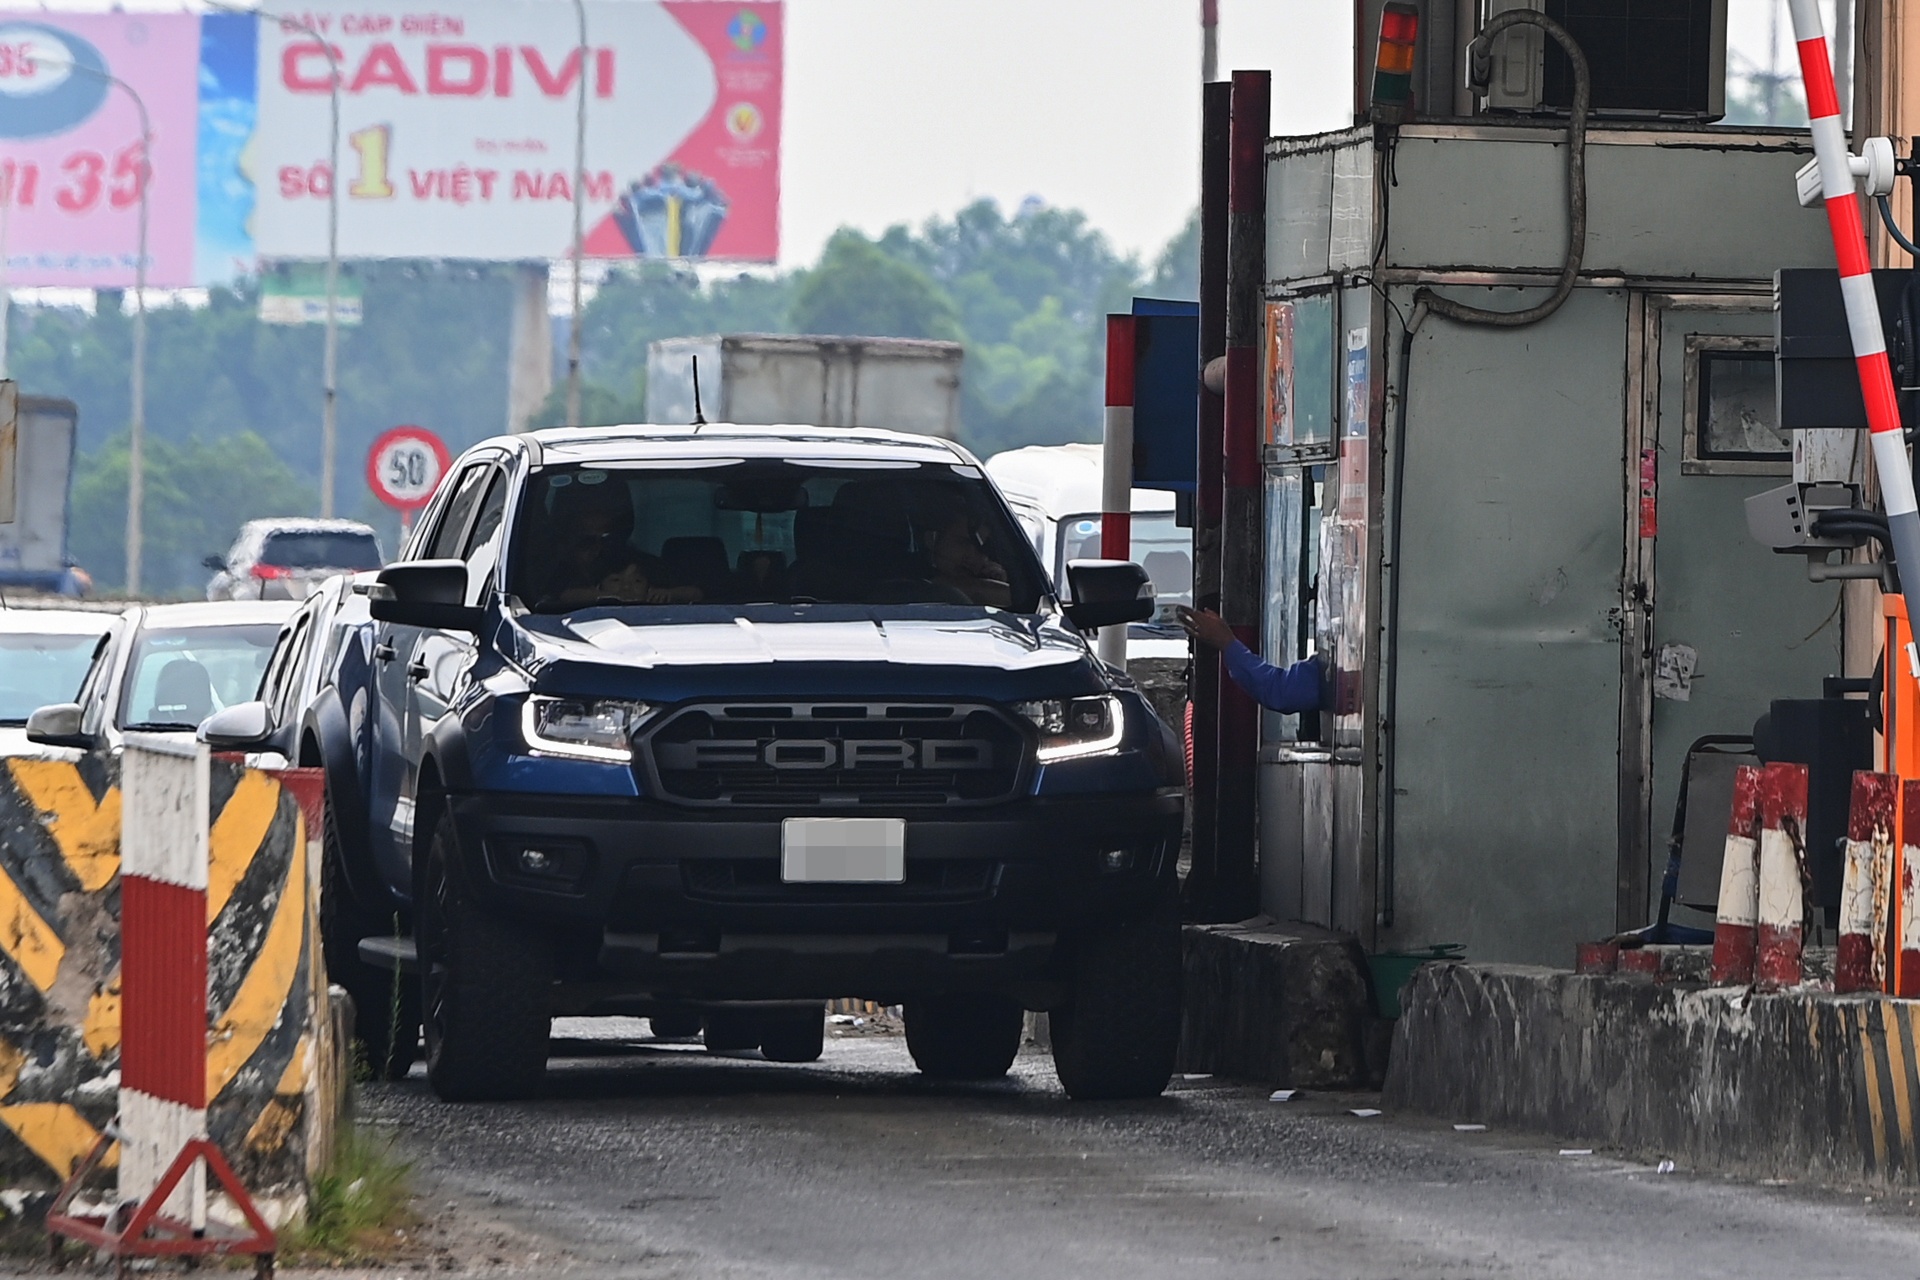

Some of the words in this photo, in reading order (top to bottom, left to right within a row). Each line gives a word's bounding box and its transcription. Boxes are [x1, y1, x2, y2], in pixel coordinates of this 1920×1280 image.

[281, 42, 616, 98] CADIVI
[348, 122, 396, 198] 1
[407, 163, 500, 206] VIỆT
[513, 169, 616, 201] NAM
[390, 448, 427, 488] 50
[670, 738, 995, 769] FORD
